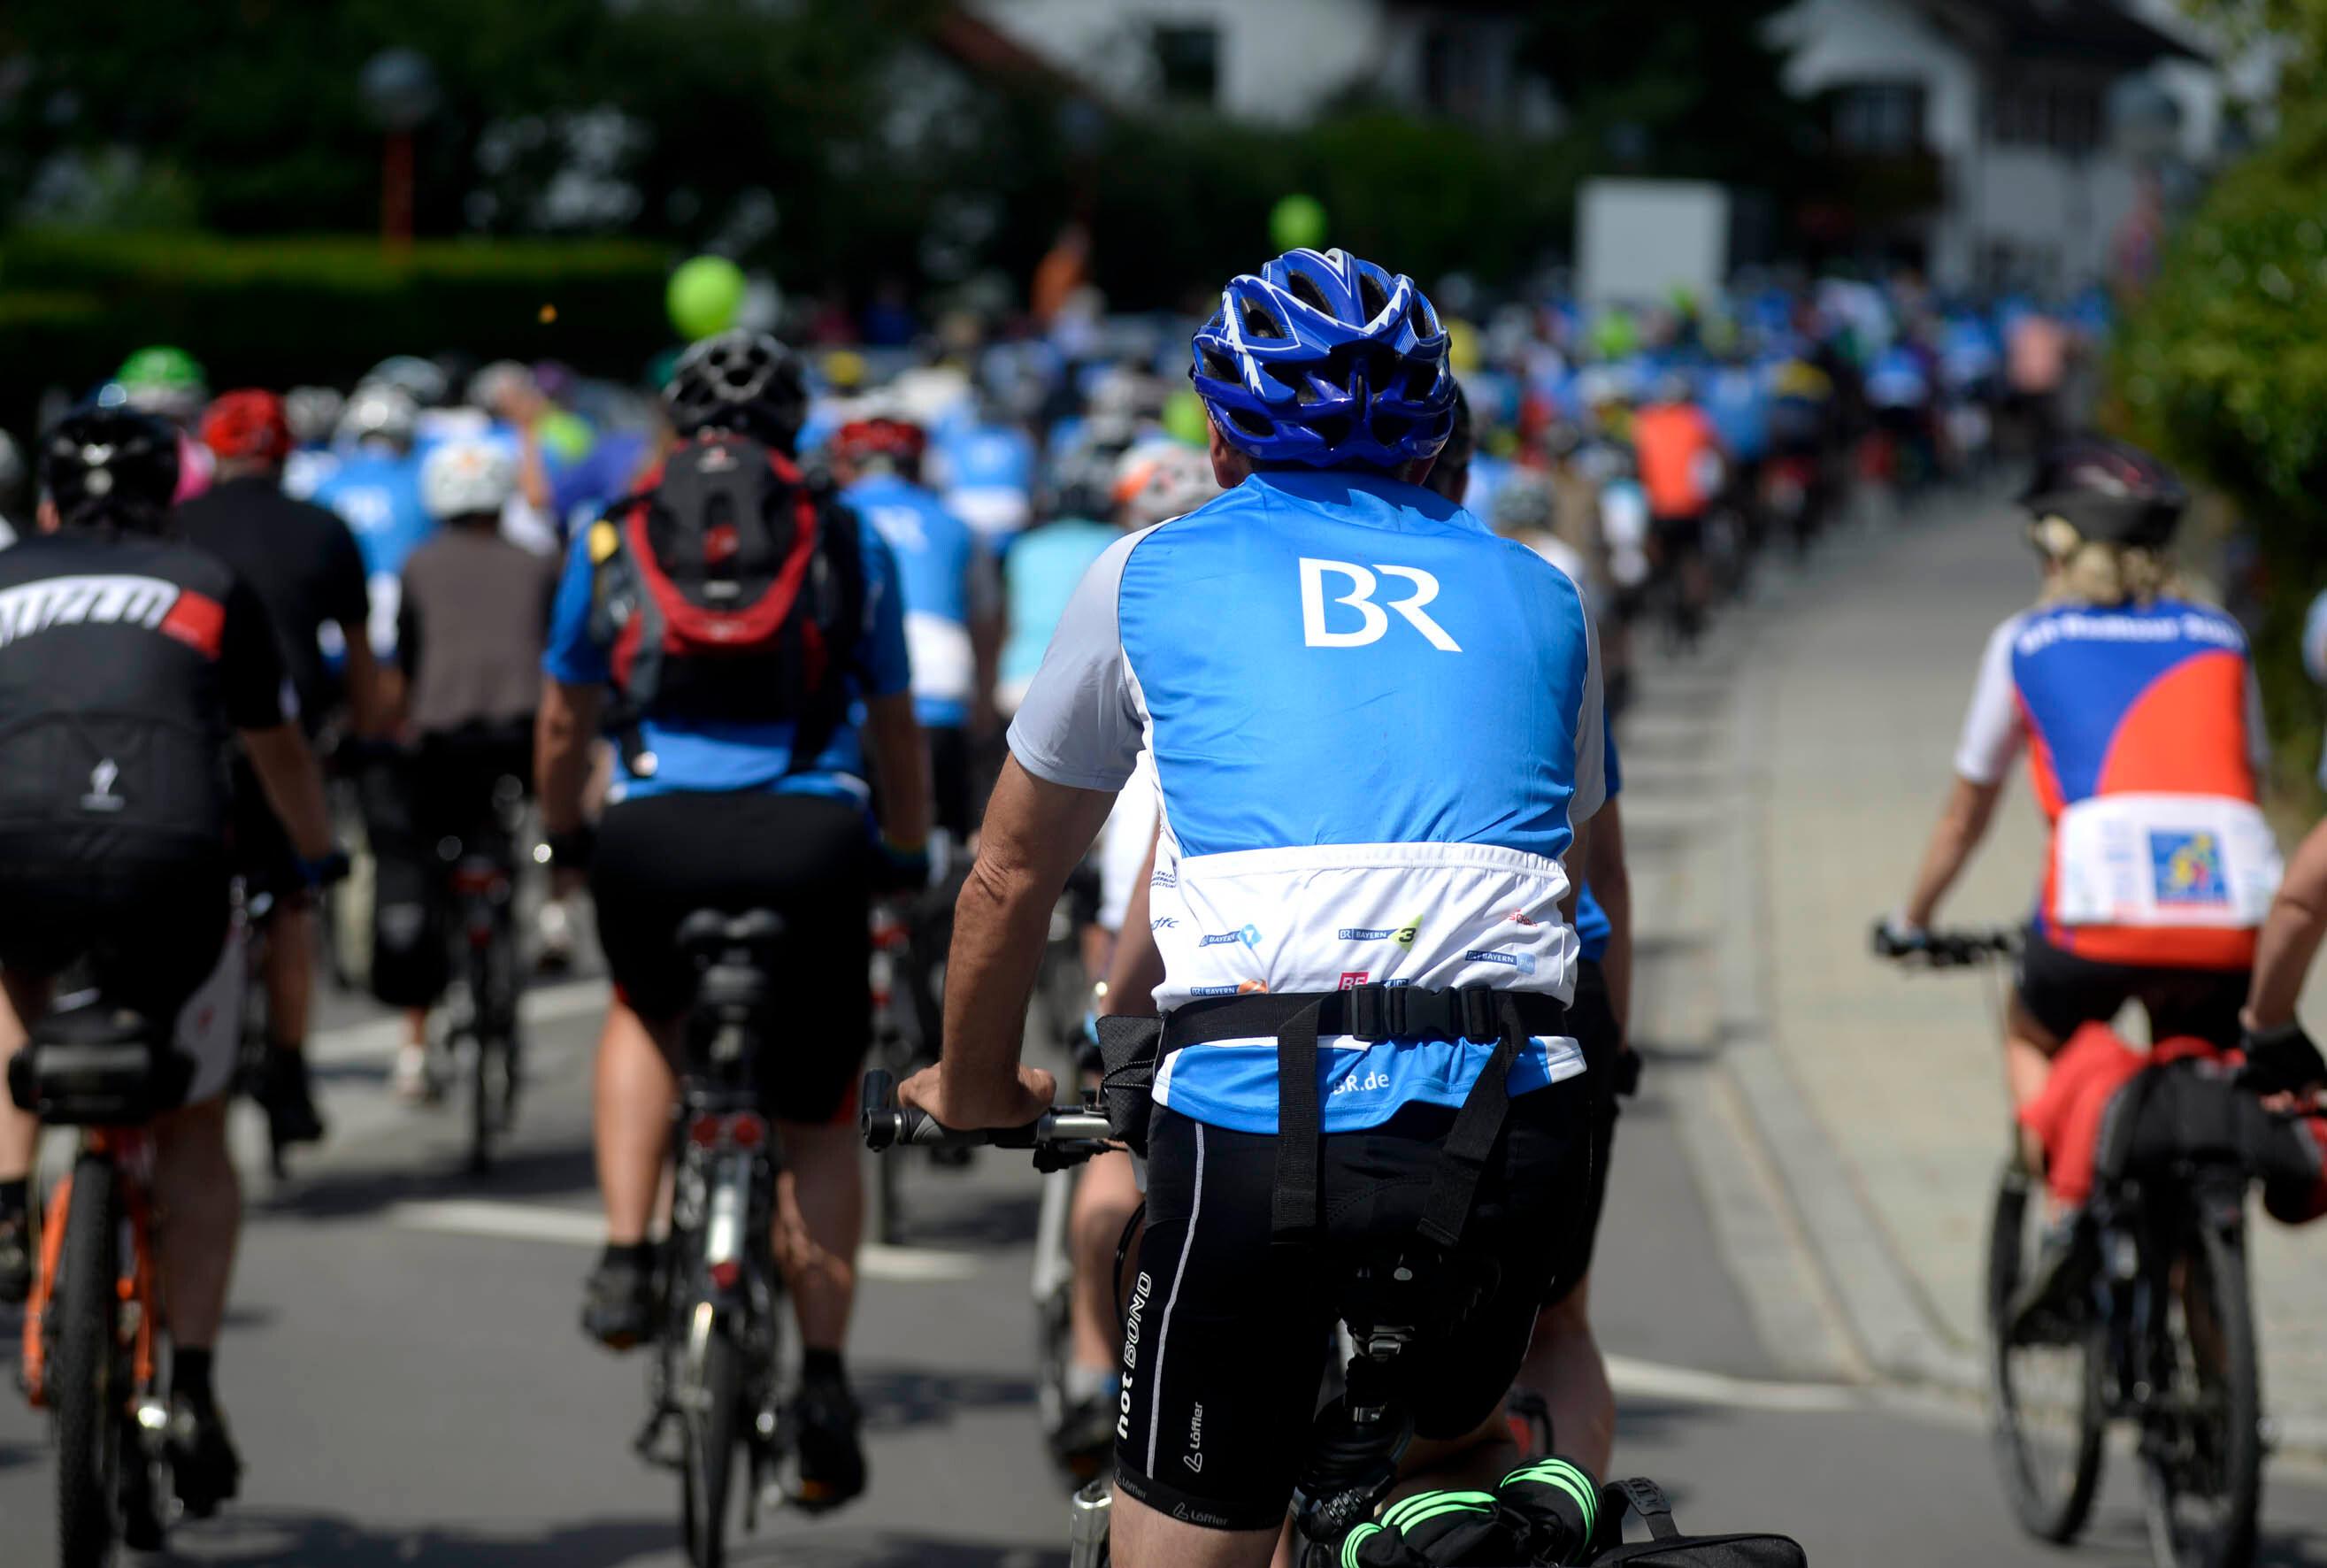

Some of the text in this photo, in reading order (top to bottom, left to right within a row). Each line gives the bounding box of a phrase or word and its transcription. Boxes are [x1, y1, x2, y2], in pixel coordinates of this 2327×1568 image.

[1299, 557, 1463, 652] BR
[1340, 927, 1416, 942] BR BAYERN 3
[1482, 952, 1514, 963] BAYERN
[1205, 987, 1235, 995] BAYERN
[1117, 1272, 1151, 1440] hot BOND
[1190, 1402, 1203, 1449] Löffler
